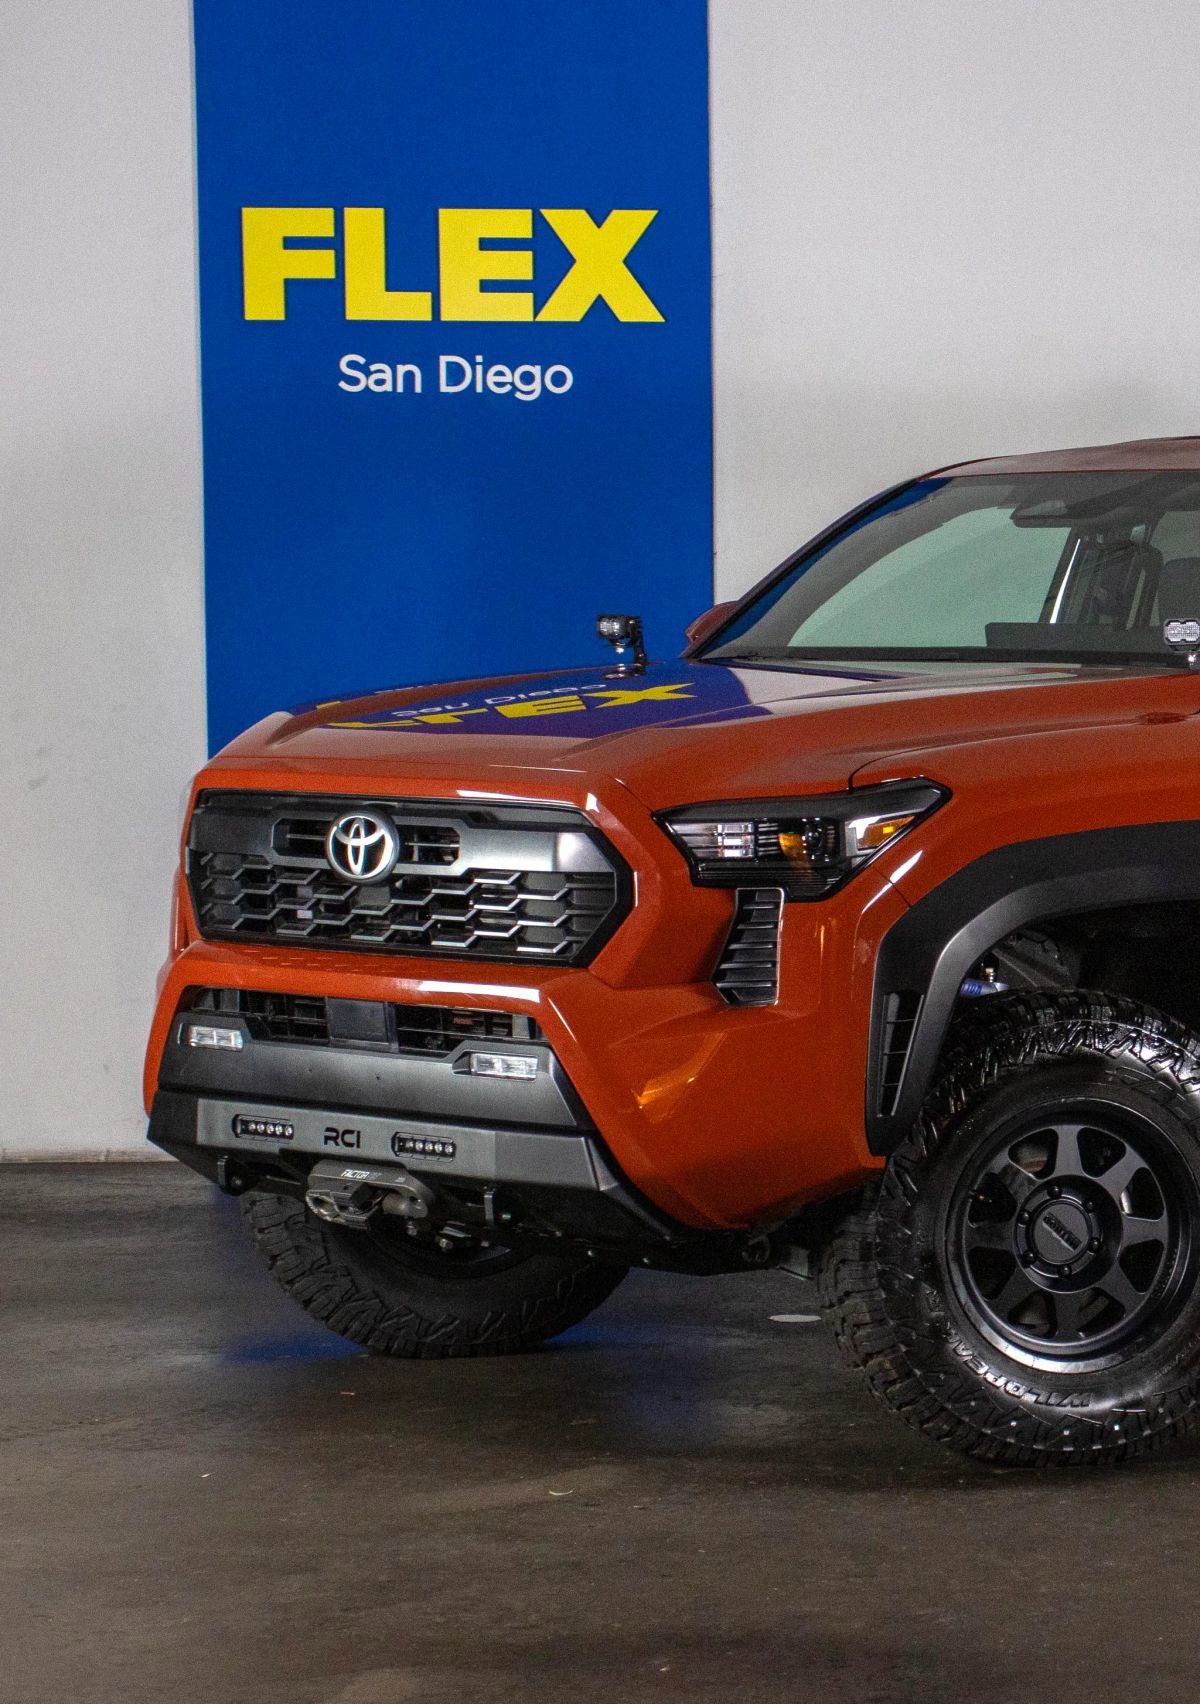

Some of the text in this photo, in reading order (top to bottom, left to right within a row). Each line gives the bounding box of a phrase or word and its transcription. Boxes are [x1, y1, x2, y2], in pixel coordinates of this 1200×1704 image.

[241, 207, 666, 323] FLEX
[338, 354, 574, 401] San Diego
[323, 1127, 361, 1149] RCI
